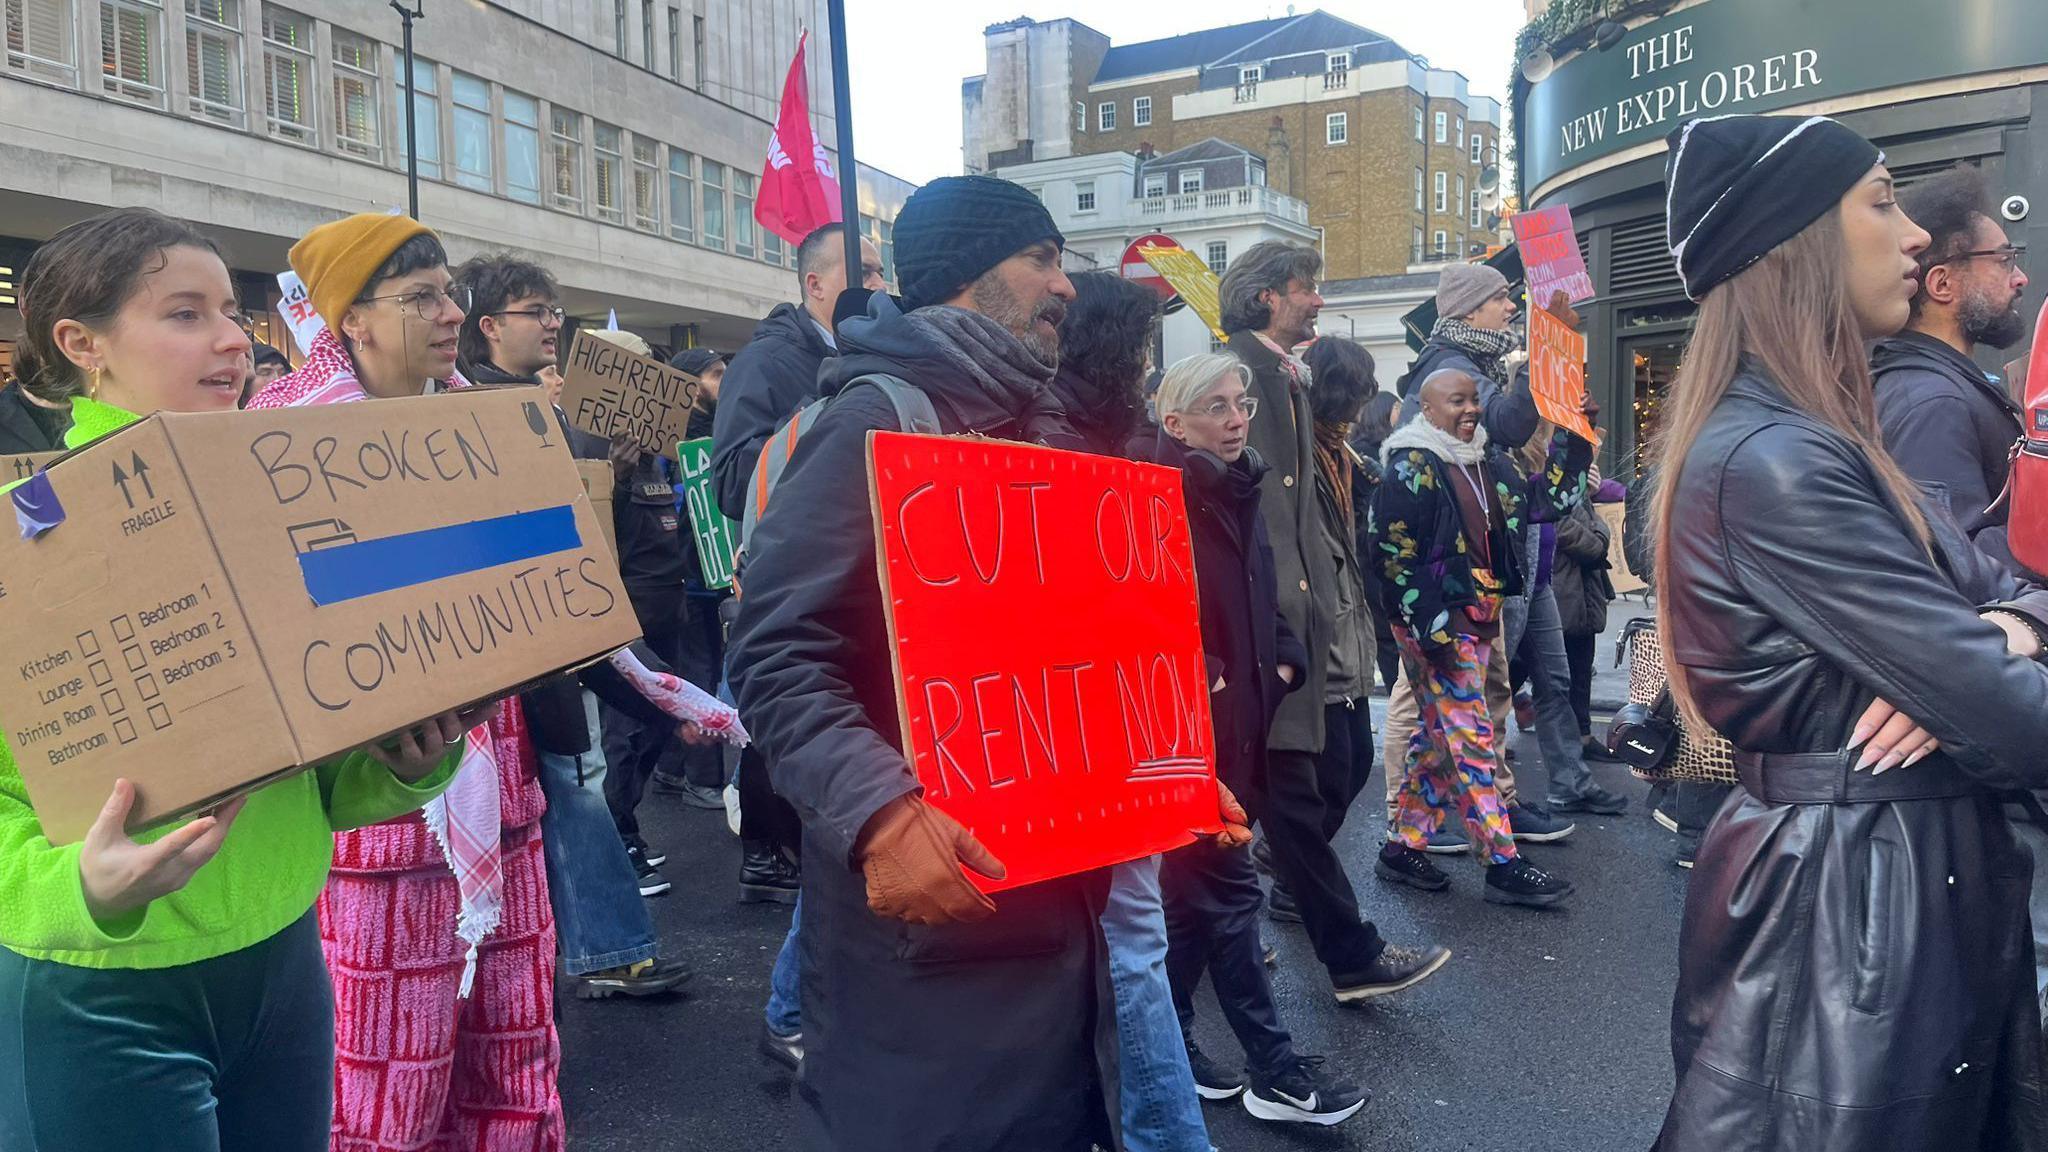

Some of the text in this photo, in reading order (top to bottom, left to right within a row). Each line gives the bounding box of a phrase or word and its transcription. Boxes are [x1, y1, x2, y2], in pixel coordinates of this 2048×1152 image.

[1627, 25, 1694, 80] THE
[1560, 48, 1822, 157] NEW EXPLORER
[574, 337, 697, 409] HIGH RENTS
[1532, 338, 1581, 413] HOMES
[576, 398, 666, 453] FRIENDS
[251, 411, 499, 504] BROKEN
[121, 500, 176, 536] FRAGILE
[898, 480, 1186, 585] CUT OUR
[138, 582, 211, 627] Bedroom 1
[150, 611, 225, 655] Bedroom 2
[303, 557, 615, 710] COMMUNITIES
[20, 648, 72, 680] Kitchen
[162, 640, 237, 685] Bedroom 3
[39, 675, 85, 706] Lounge
[18, 704, 96, 747] Dining Room
[48, 732, 108, 765] Bathroom
[922, 661, 1094, 797] RENT
